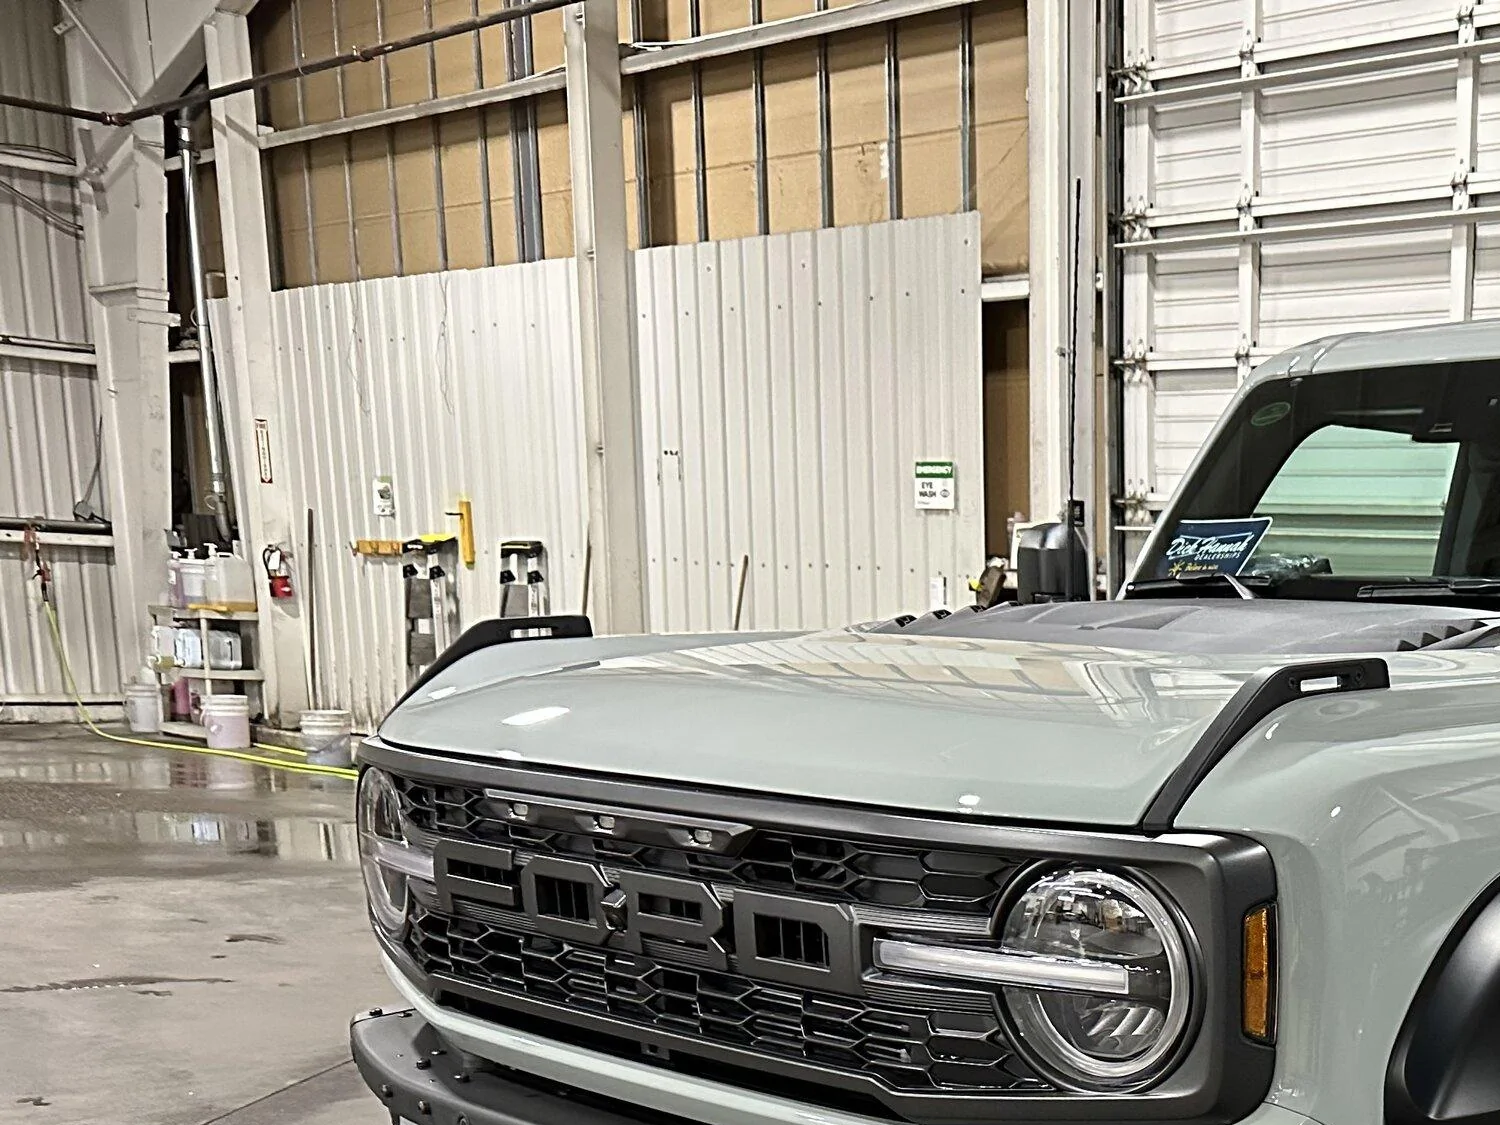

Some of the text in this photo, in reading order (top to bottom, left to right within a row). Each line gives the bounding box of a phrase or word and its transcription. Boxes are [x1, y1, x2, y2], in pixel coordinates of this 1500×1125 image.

[921, 481, 933, 489] EYE
[918, 490, 937, 498] WASH
[1166, 537, 1248, 556] Dick Hannah
[1194, 551, 1241, 561] DEALERSHIPS
[433, 838, 868, 996] FORD
